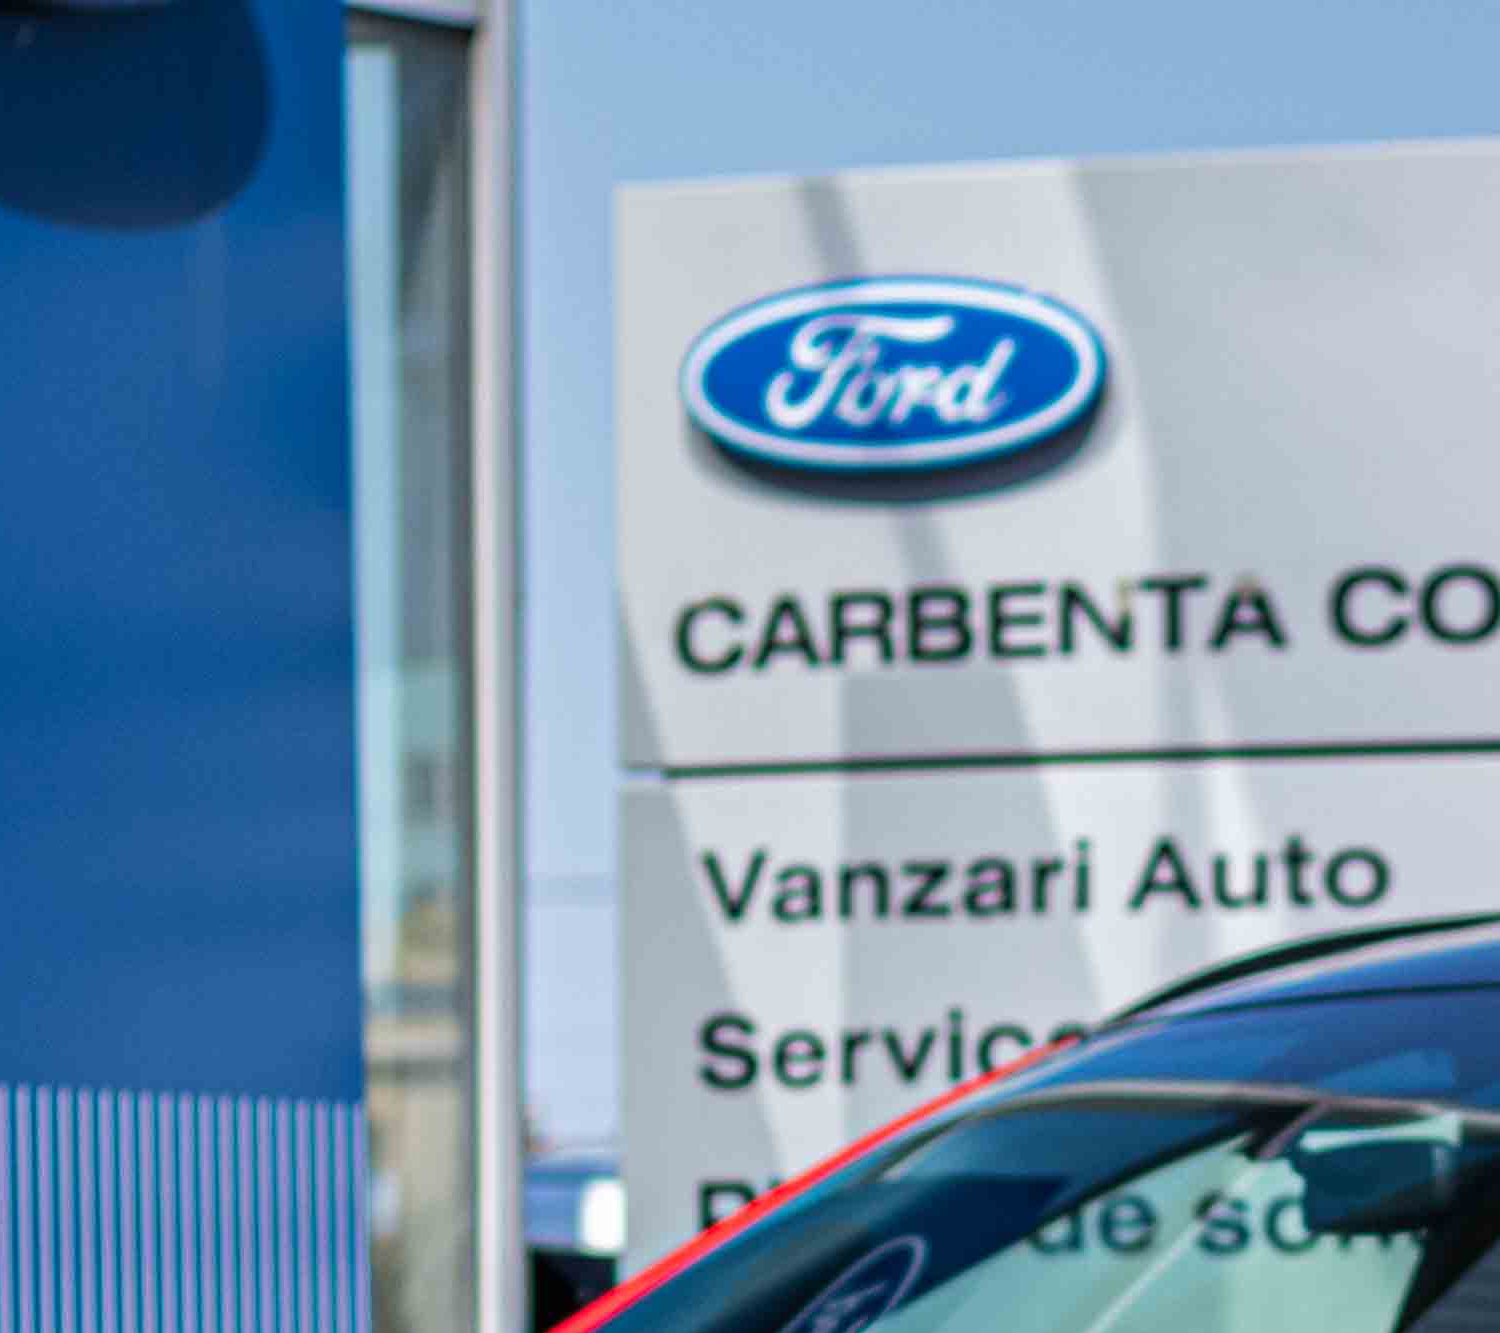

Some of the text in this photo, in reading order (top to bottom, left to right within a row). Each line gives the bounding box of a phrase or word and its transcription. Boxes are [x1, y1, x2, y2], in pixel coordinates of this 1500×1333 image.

[763, 314, 1016, 430] Ford
[673, 571, 1290, 677] CARBENTA
[698, 834, 1393, 926] Vanzari Auto
[698, 1005, 1090, 1092] Servic
